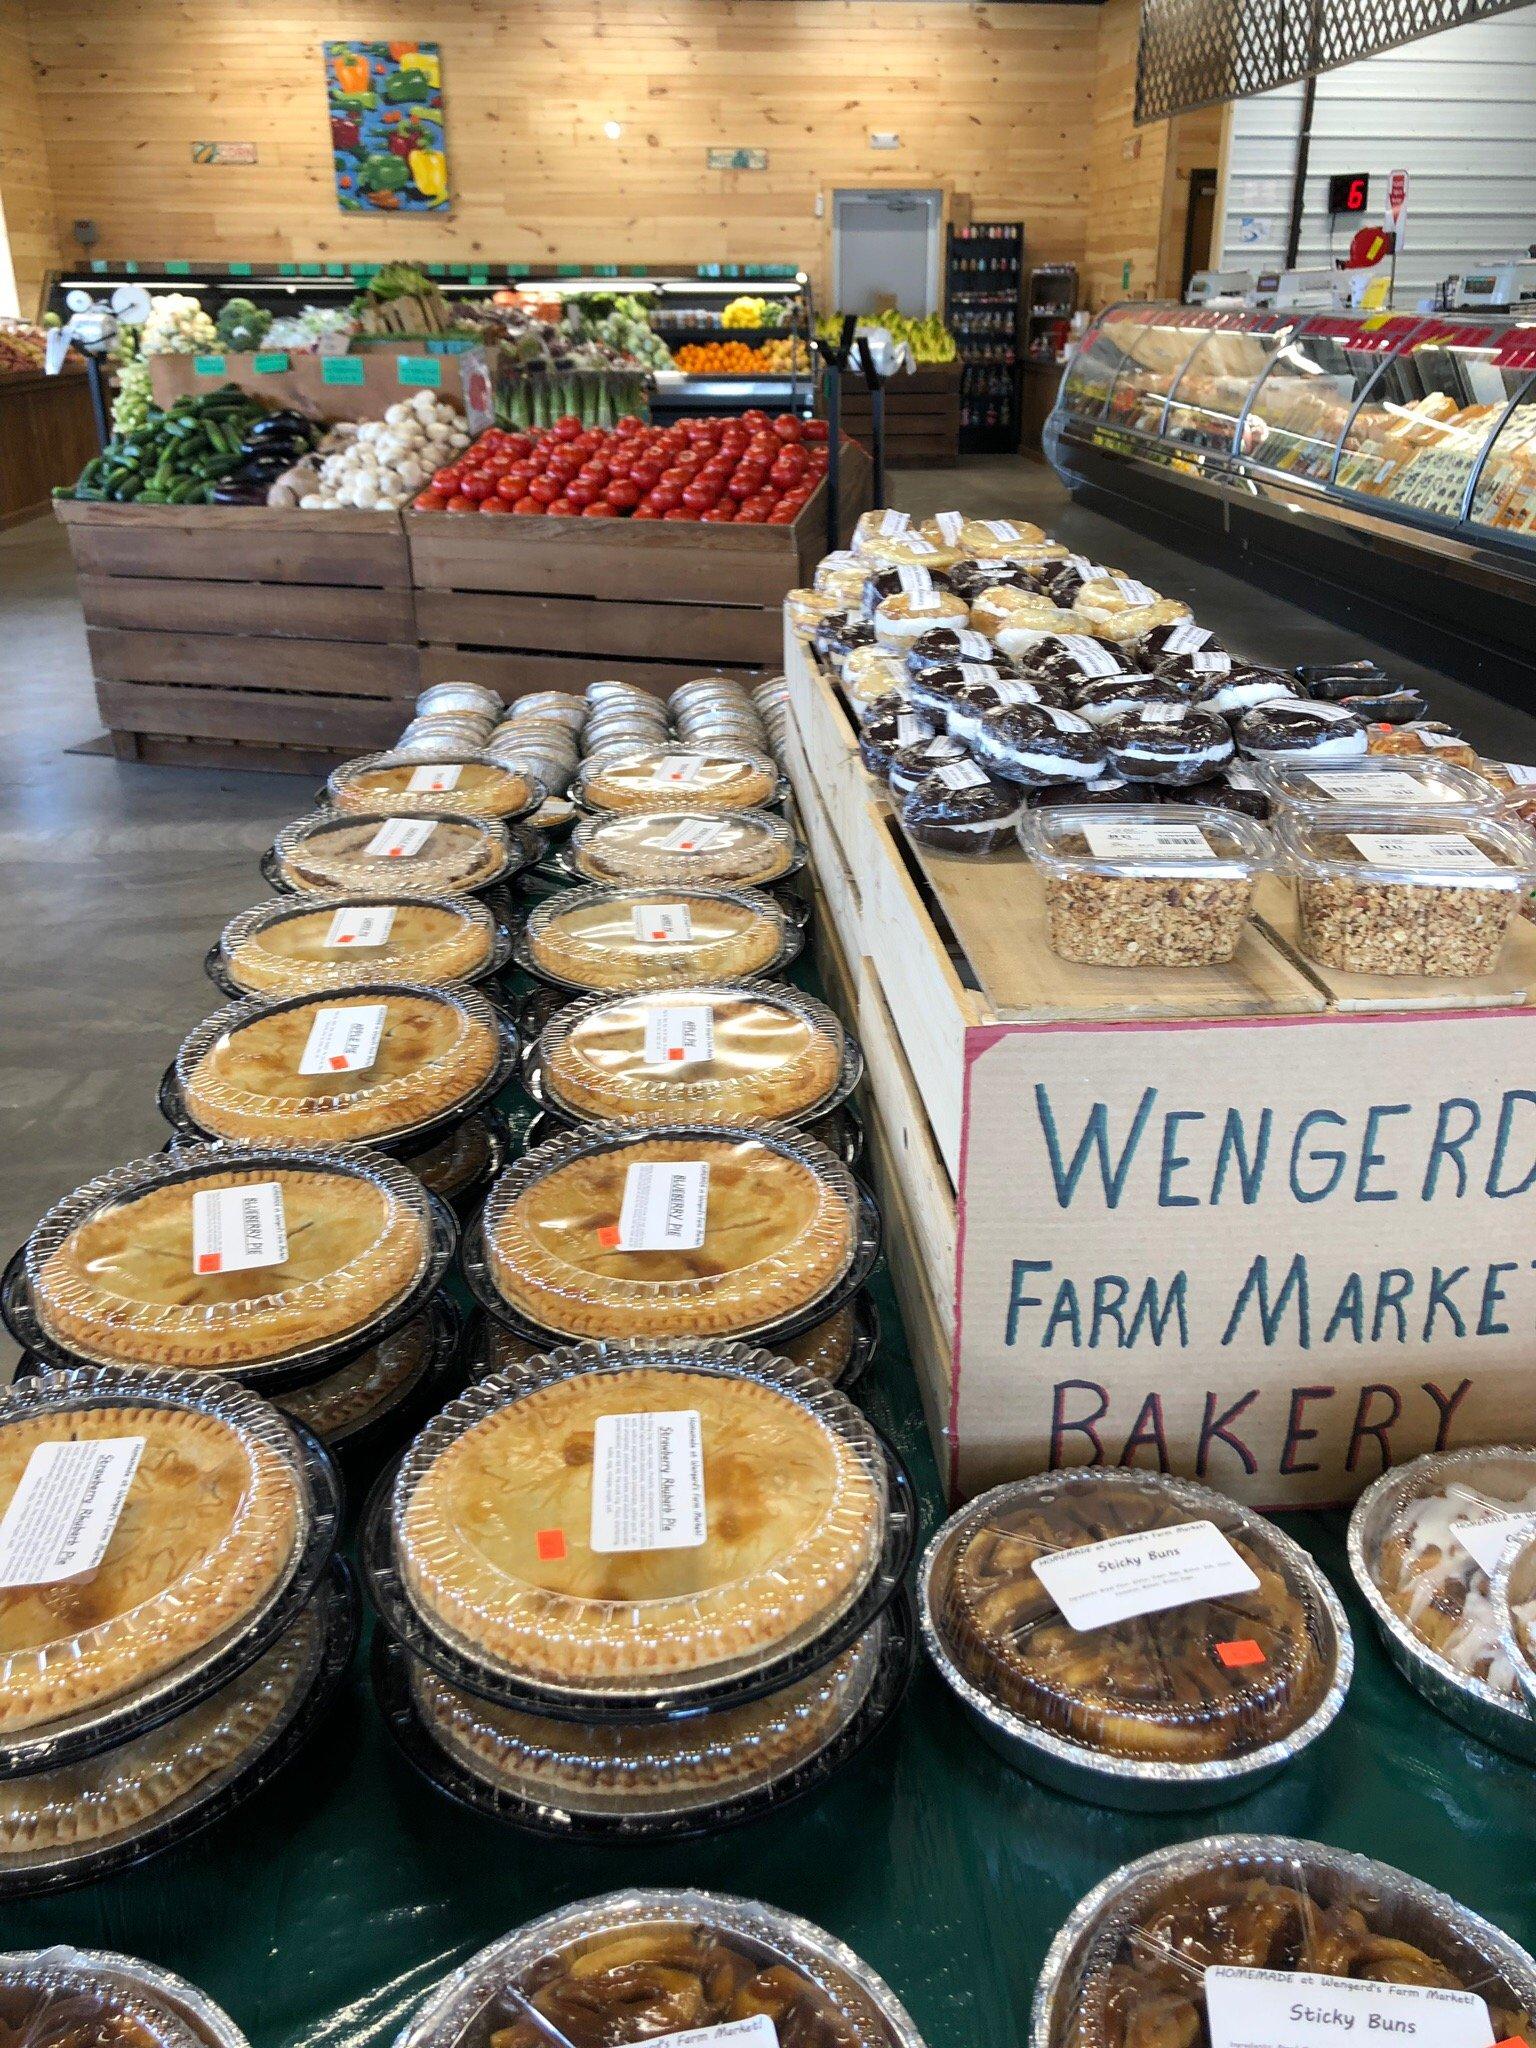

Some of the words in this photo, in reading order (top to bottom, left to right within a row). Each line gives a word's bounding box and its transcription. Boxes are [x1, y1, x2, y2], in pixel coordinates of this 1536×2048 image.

[1349, 181, 1365, 208] 6
[1034, 1081, 1536, 1210] WENGERD
[669, 1175, 686, 1220] BLUEBERRY
[244, 1198, 262, 1239] BLUEBERRY
[668, 1223, 684, 1236] PIE
[247, 1243, 263, 1255] PIE
[1004, 1258, 1190, 1349] FARM
[1220, 1253, 1536, 1349] MARKE
[1048, 1377, 1473, 1476] BAKERY
[660, 1427, 674, 1473] Strawberry
[83, 1454, 114, 1504] Strawberry
[661, 1478, 676, 1513] Rhubarb
[67, 1508, 93, 1546] Rhubarb
[662, 1518, 677, 1532] Pie
[58, 1551, 76, 1566] Pie
[1039, 1547, 1091, 1567] HOMEMADE
[1096, 1543, 1105, 1552] at
[1109, 1533, 1149, 1549] Wengerd's
[1152, 1529, 1173, 1539] Farm
[1097, 1556, 1142, 1574] Sticky
[1148, 1547, 1181, 1561] Buns
[1215, 1967, 1295, 1985] HOMEMADE
[1301, 1976, 1315, 1985] at
[1321, 1977, 1382, 1995] Wengerd's
[1389, 1985, 1420, 1998] Farm
[1426, 1990, 1476, 2006] Market!
[677, 2033, 709, 2046] Farm
[714, 2017, 764, 2039] Market!
[1289, 2003, 1356, 2031] Sticky
[1368, 2013, 1417, 2034] Buns
